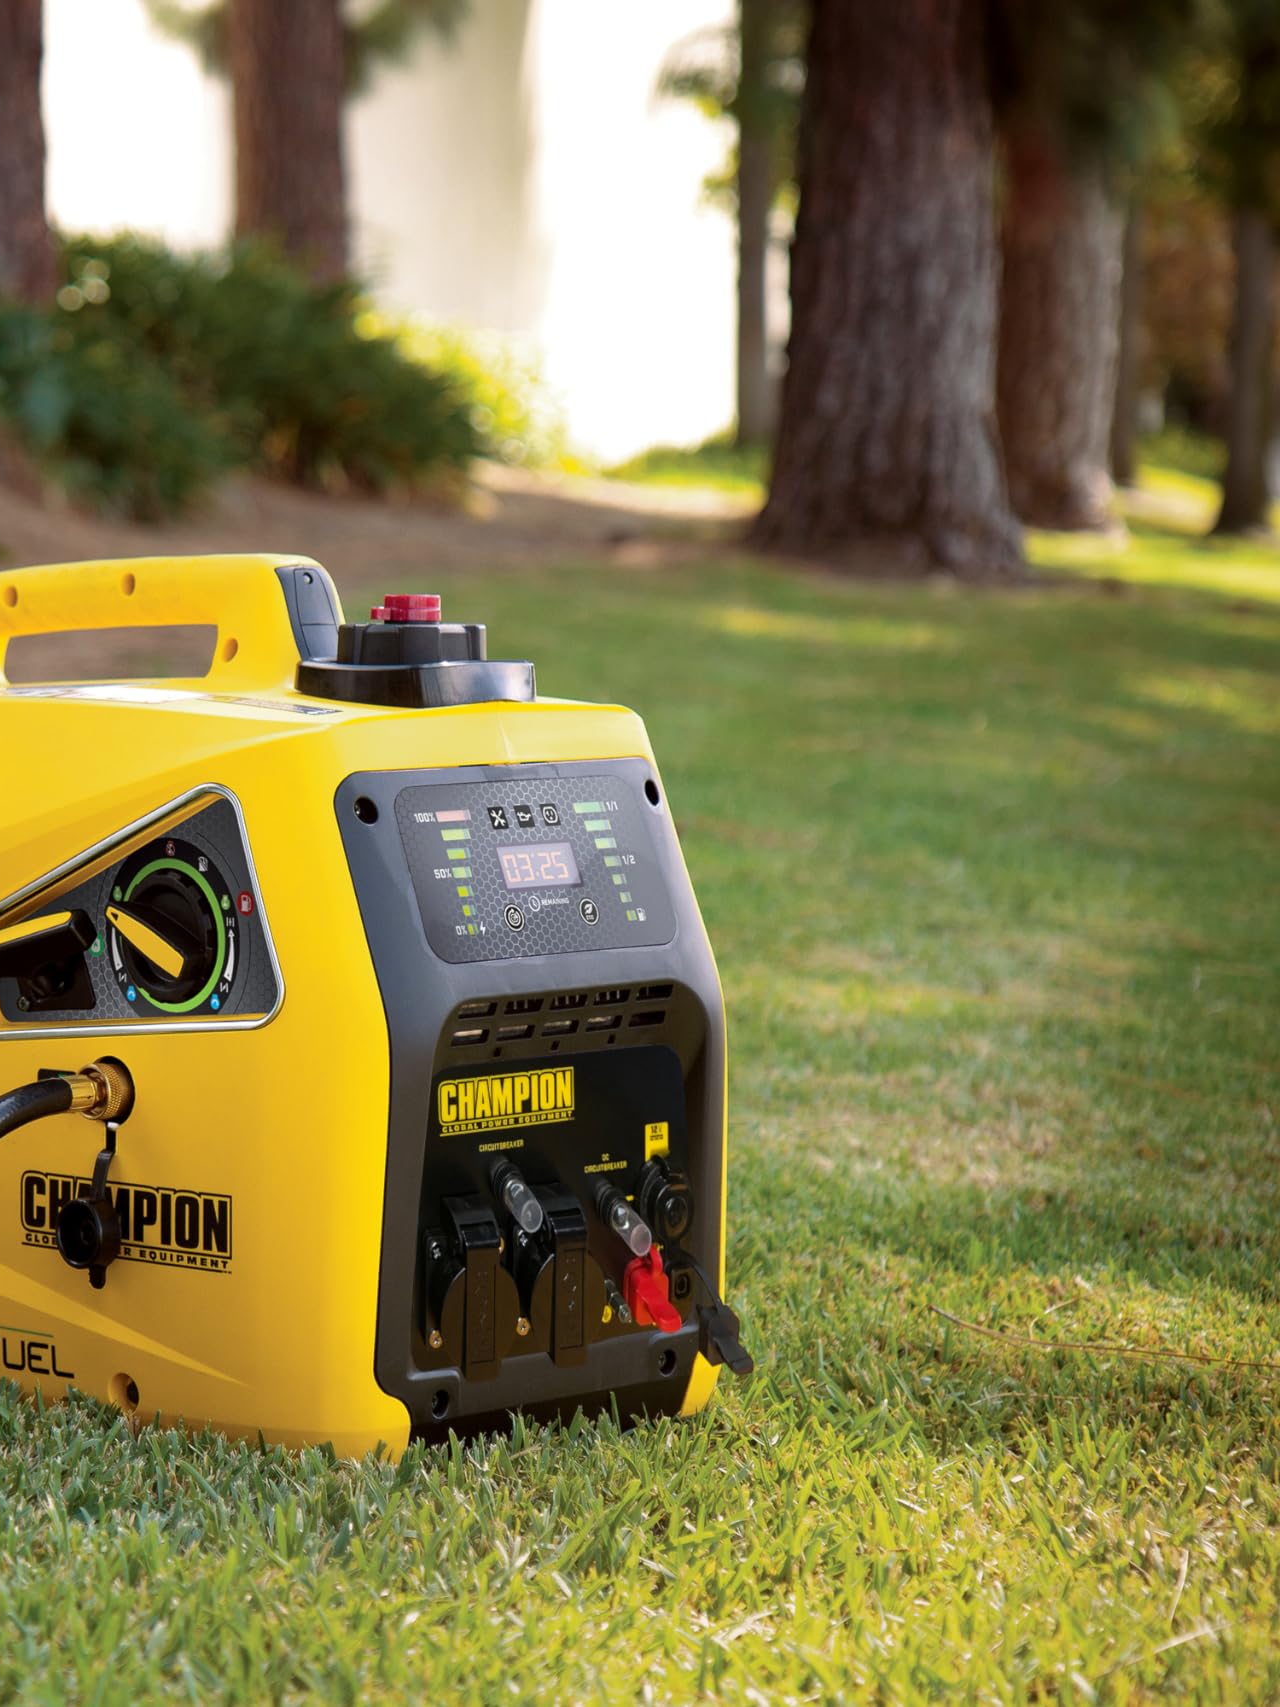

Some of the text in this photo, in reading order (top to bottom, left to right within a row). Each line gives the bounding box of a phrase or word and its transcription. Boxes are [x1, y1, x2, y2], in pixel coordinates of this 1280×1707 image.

[606, 801, 618, 811] 1/1
[414, 812, 435, 823] 100%
[622, 855, 636, 865] 1/2
[434, 868, 452, 879] 50%
[456, 925, 467, 935] 0%
[440, 1070, 572, 1123] CHAMPION
[442, 1122, 479, 1133] GLOBAL
[482, 1118, 514, 1128] POWER
[519, 1111, 572, 1124] EQUIPMENT
[24, 1174, 228, 1253] CHMPION
[139, 1249, 229, 1269] EQUIPMENT
